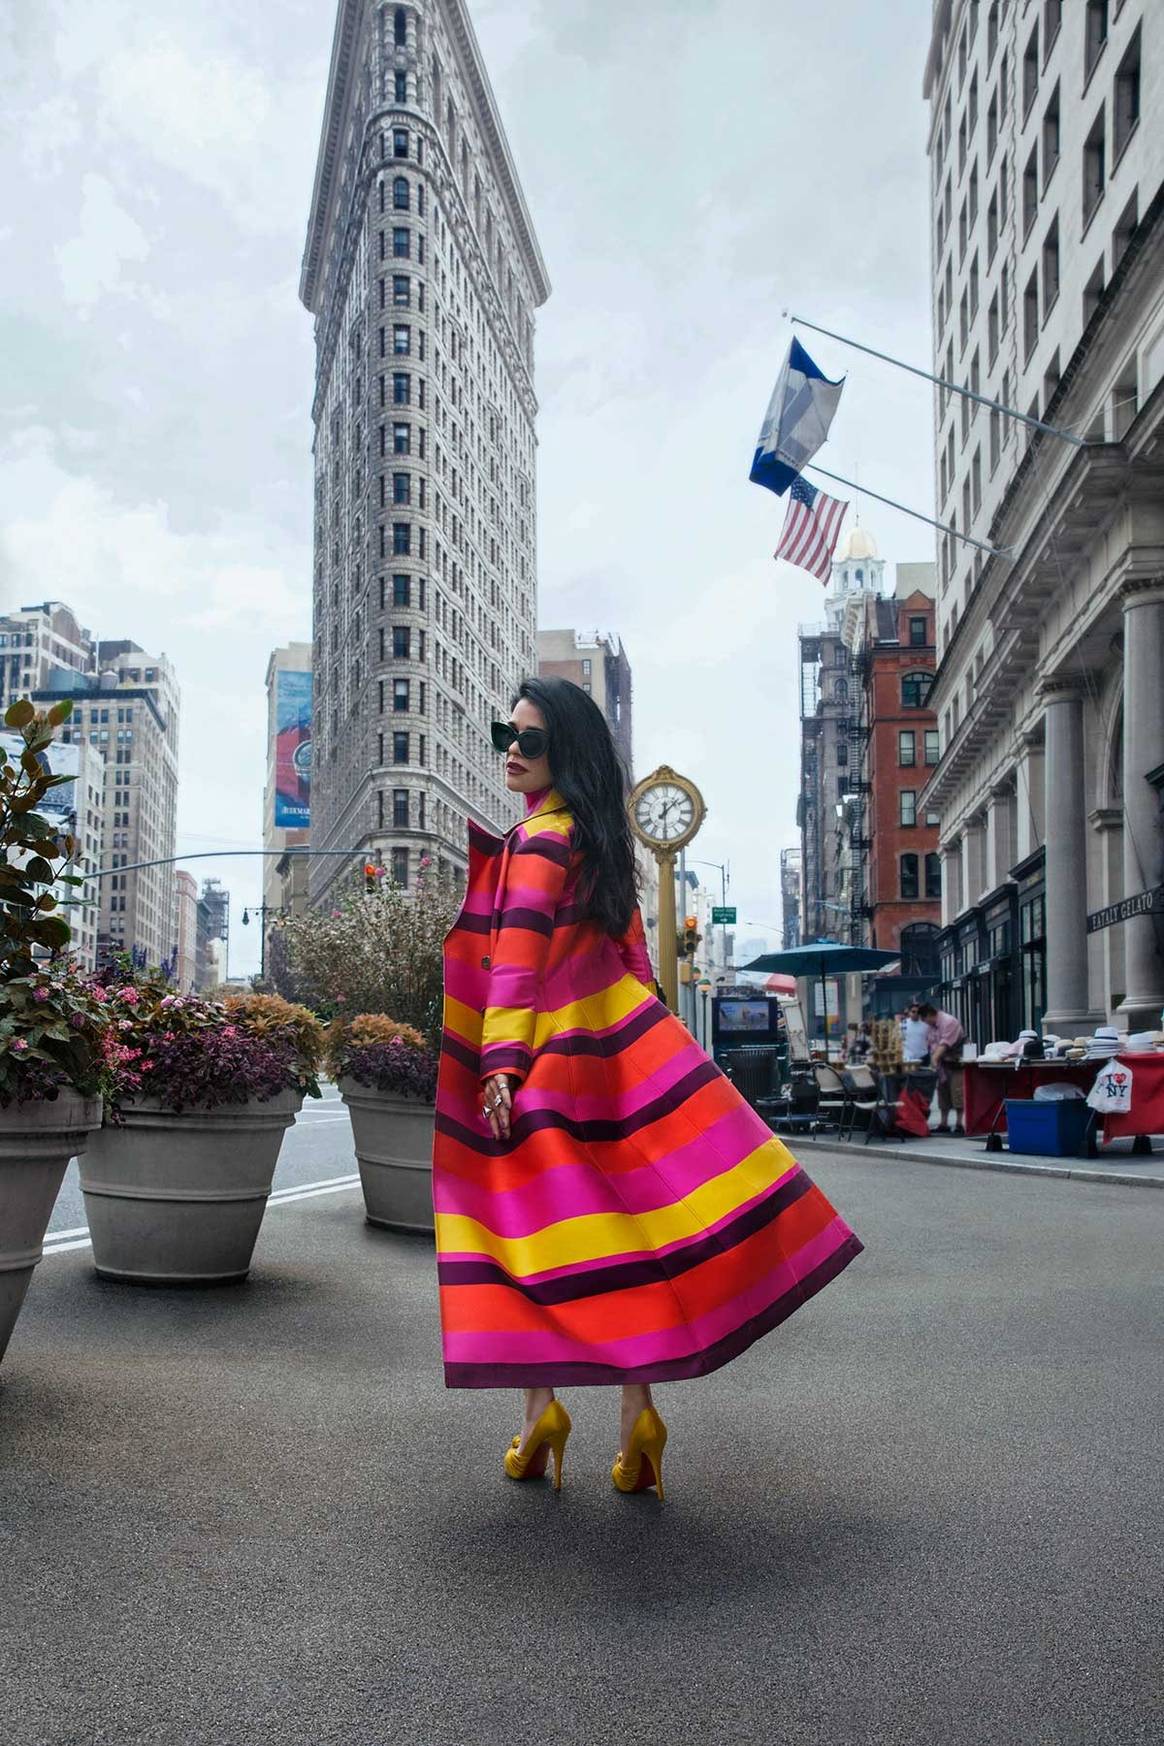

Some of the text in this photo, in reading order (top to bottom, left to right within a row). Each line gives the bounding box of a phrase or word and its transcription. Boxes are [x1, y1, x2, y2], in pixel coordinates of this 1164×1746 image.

[1092, 891, 1153, 930] EATALY GELATO
[1105, 1074, 1113, 1086] I
[1105, 1085, 1128, 1098] NY
